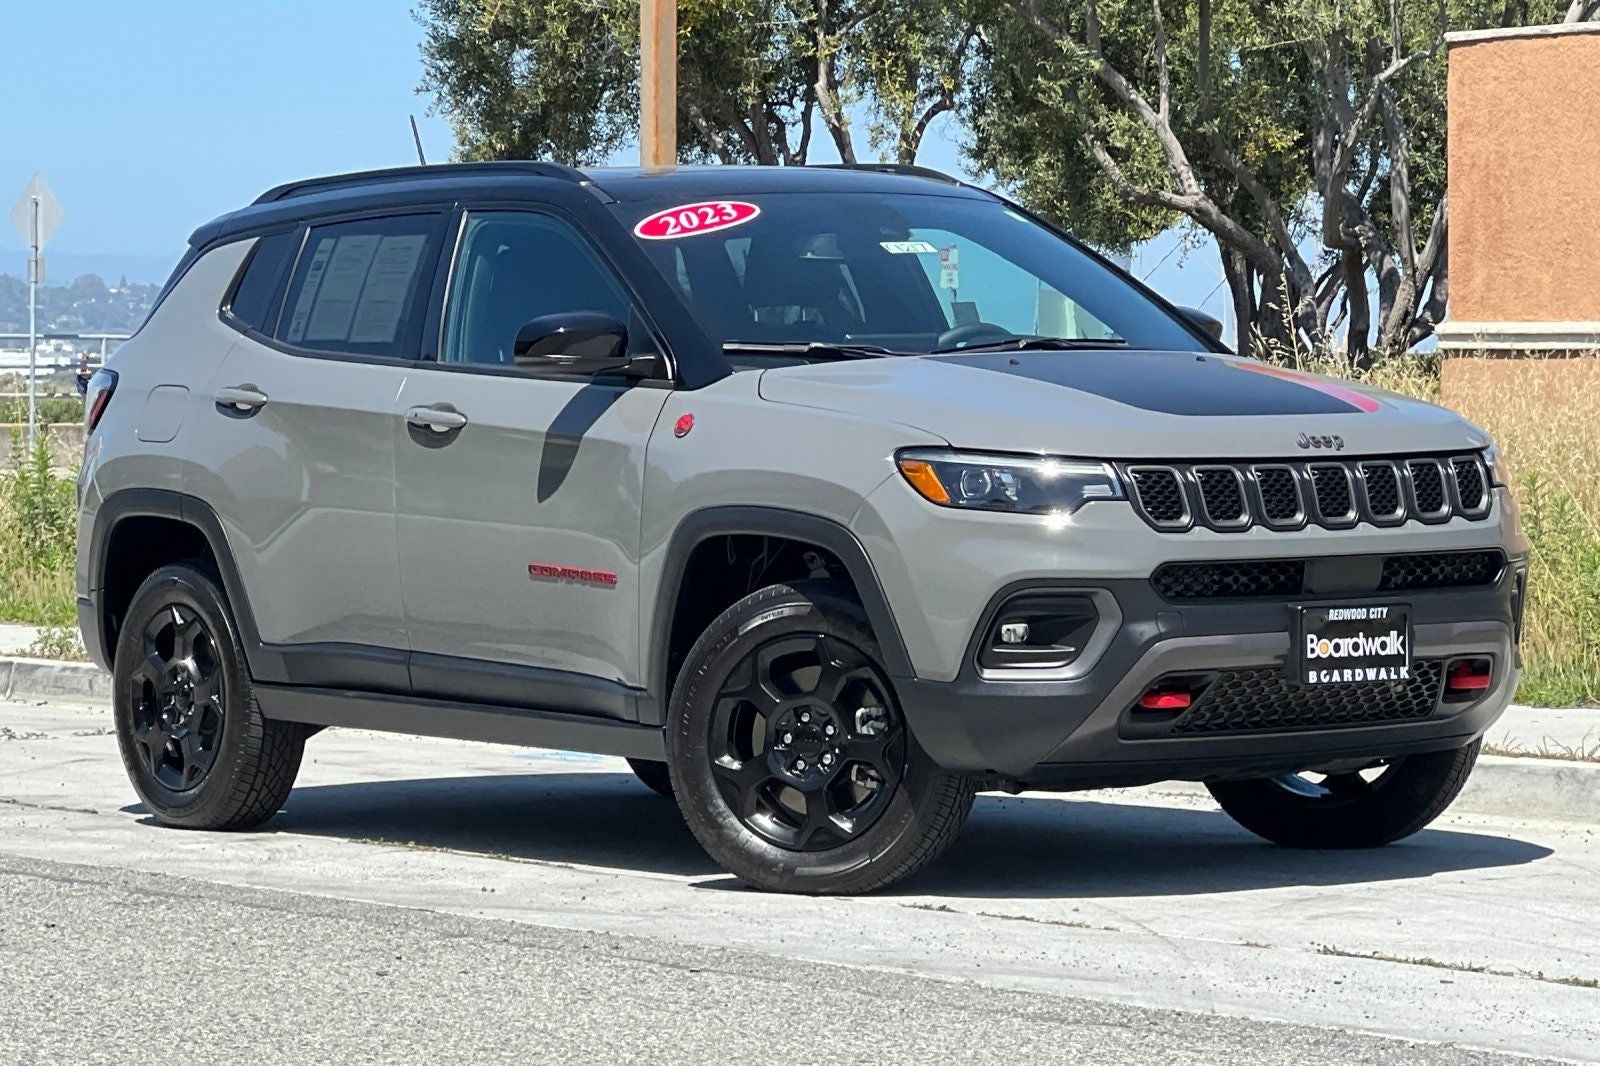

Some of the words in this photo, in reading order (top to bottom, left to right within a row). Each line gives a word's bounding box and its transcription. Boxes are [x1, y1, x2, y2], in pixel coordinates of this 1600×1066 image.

[658, 203, 738, 235] 2023
[1296, 432, 1344, 451] Jeep
[528, 563, 618, 585] COMPASS
[1328, 608, 1367, 620] REDWOOD
[1369, 607, 1388, 619] CITY
[1306, 630, 1405, 659] Boardwalk
